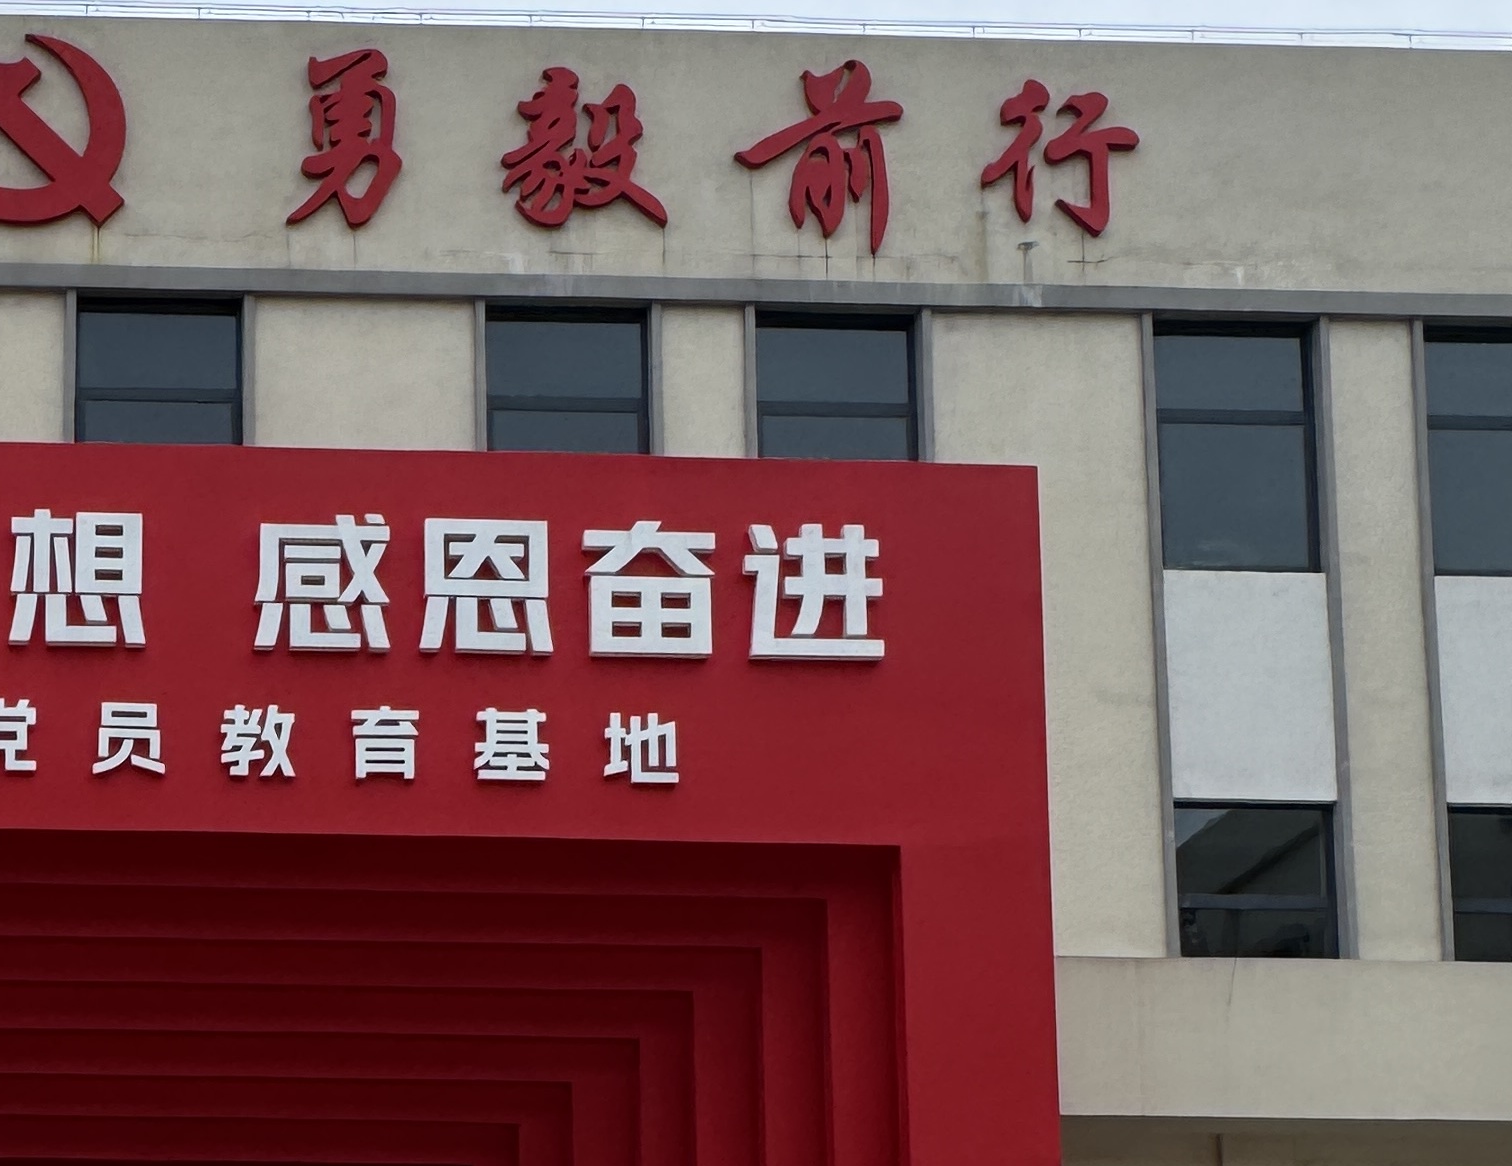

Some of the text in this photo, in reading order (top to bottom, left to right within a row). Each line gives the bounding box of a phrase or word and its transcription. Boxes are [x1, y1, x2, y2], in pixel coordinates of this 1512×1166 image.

[287, 48, 1138, 253] 勇毅前行
[253, 514, 886, 660] 感恩奋进
